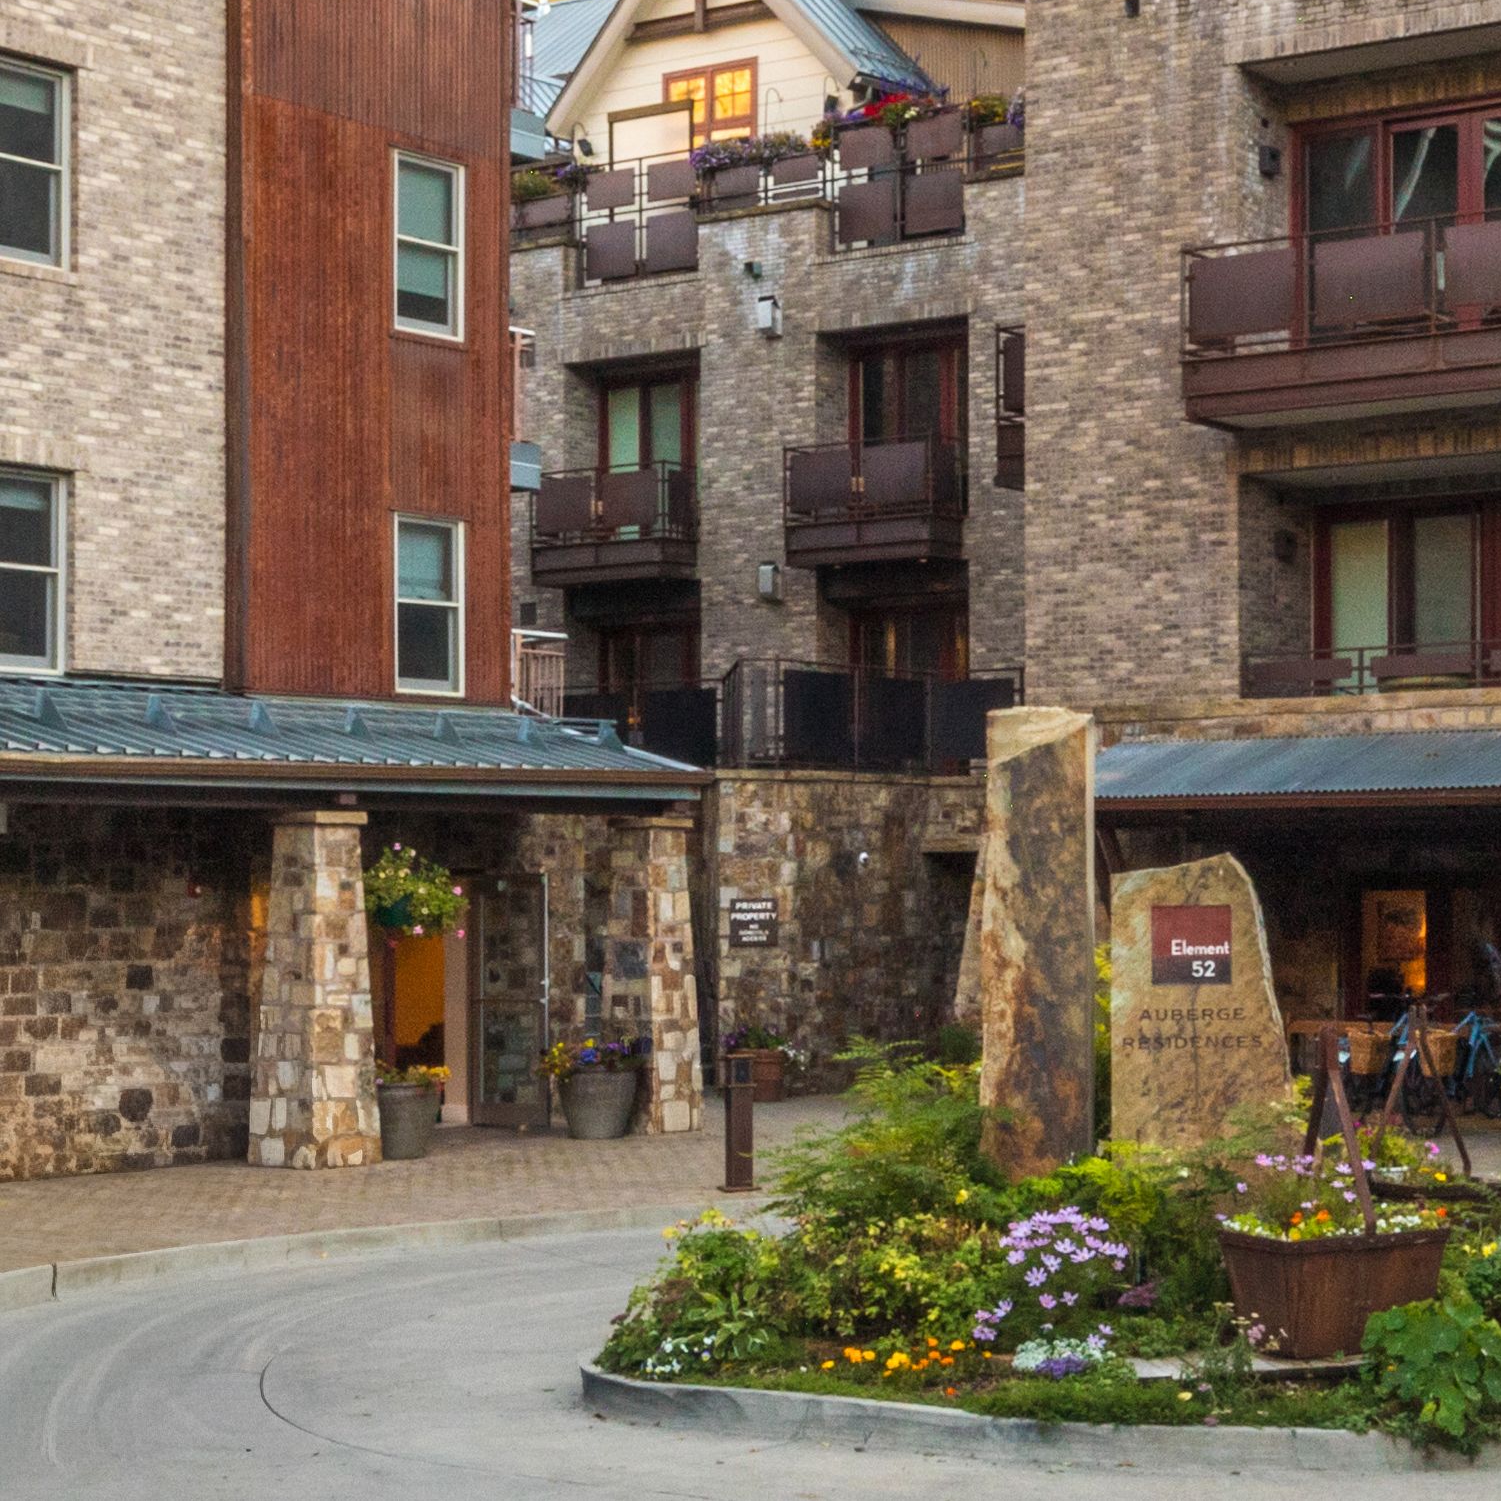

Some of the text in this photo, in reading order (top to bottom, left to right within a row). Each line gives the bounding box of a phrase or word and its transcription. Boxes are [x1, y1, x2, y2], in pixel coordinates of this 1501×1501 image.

[735, 901, 773, 910] PRIVATE
[731, 912, 777, 921] PROPERTY
[1171, 939, 1230, 956] Element
[1191, 960, 1216, 978] 52
[1139, 1007, 1246, 1021] AUBERGE
[1121, 1035, 1262, 1050] RESIDENCES
